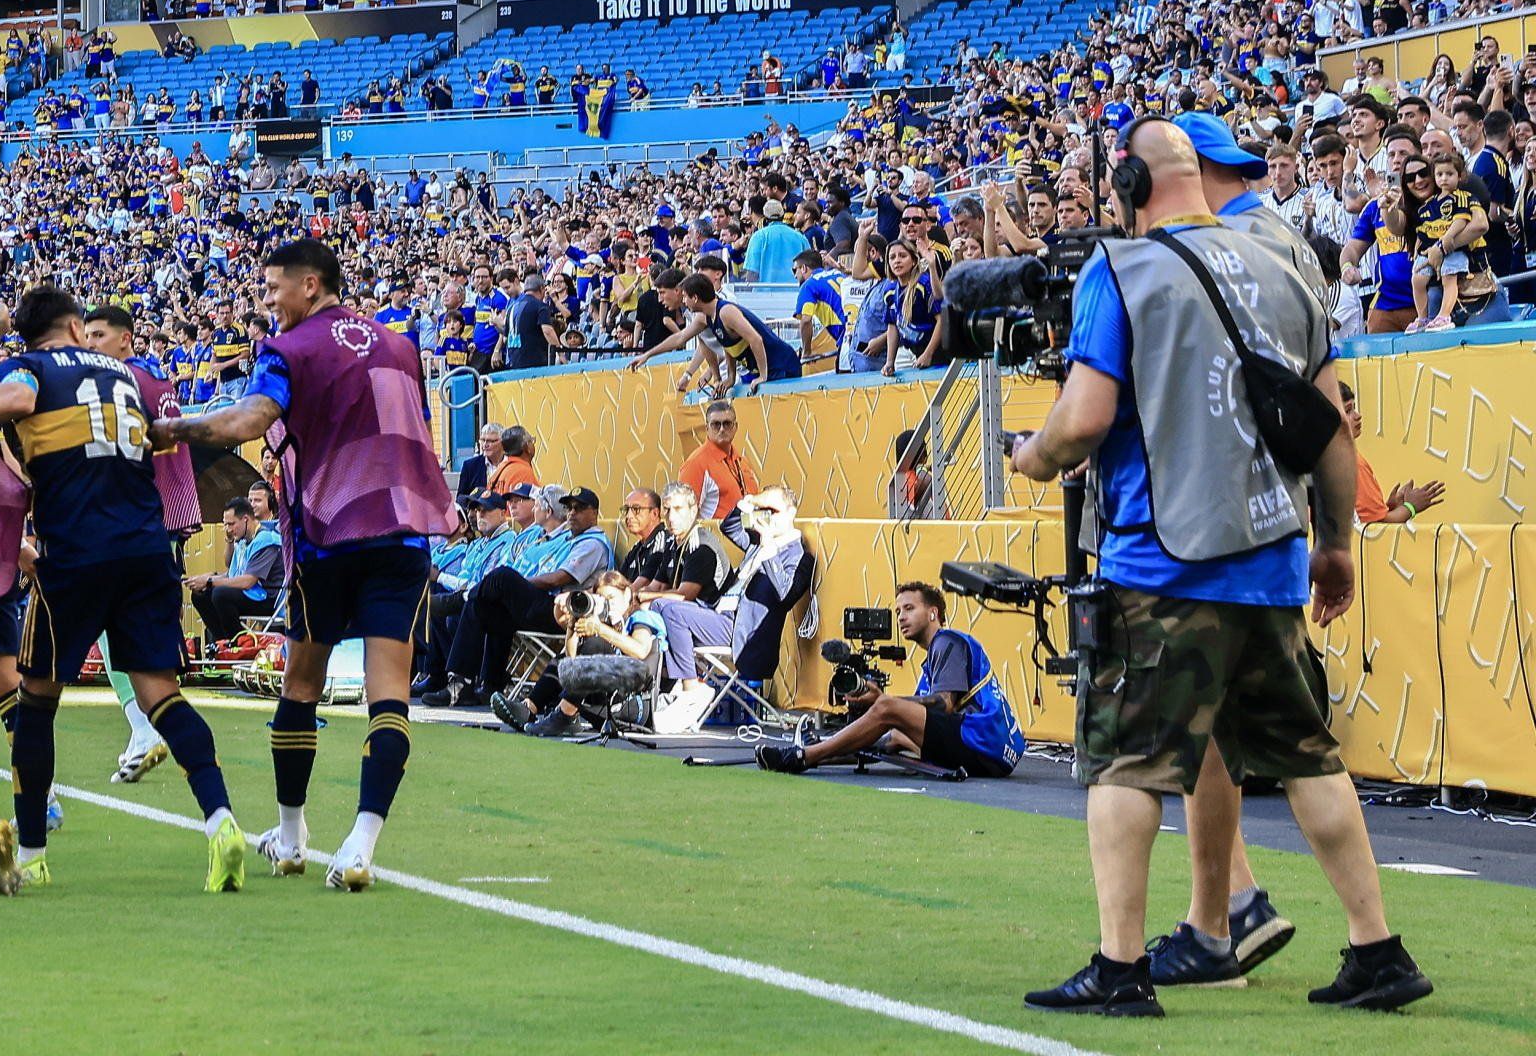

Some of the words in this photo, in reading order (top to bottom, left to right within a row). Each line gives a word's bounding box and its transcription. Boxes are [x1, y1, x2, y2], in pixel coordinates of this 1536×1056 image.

[337, 130, 353, 142] 139
[51, 351, 76, 368] M.
[1207, 355, 1226, 417] CLUB
[76, 378, 152, 462] 16
[1248, 484, 1292, 519] FIFA
